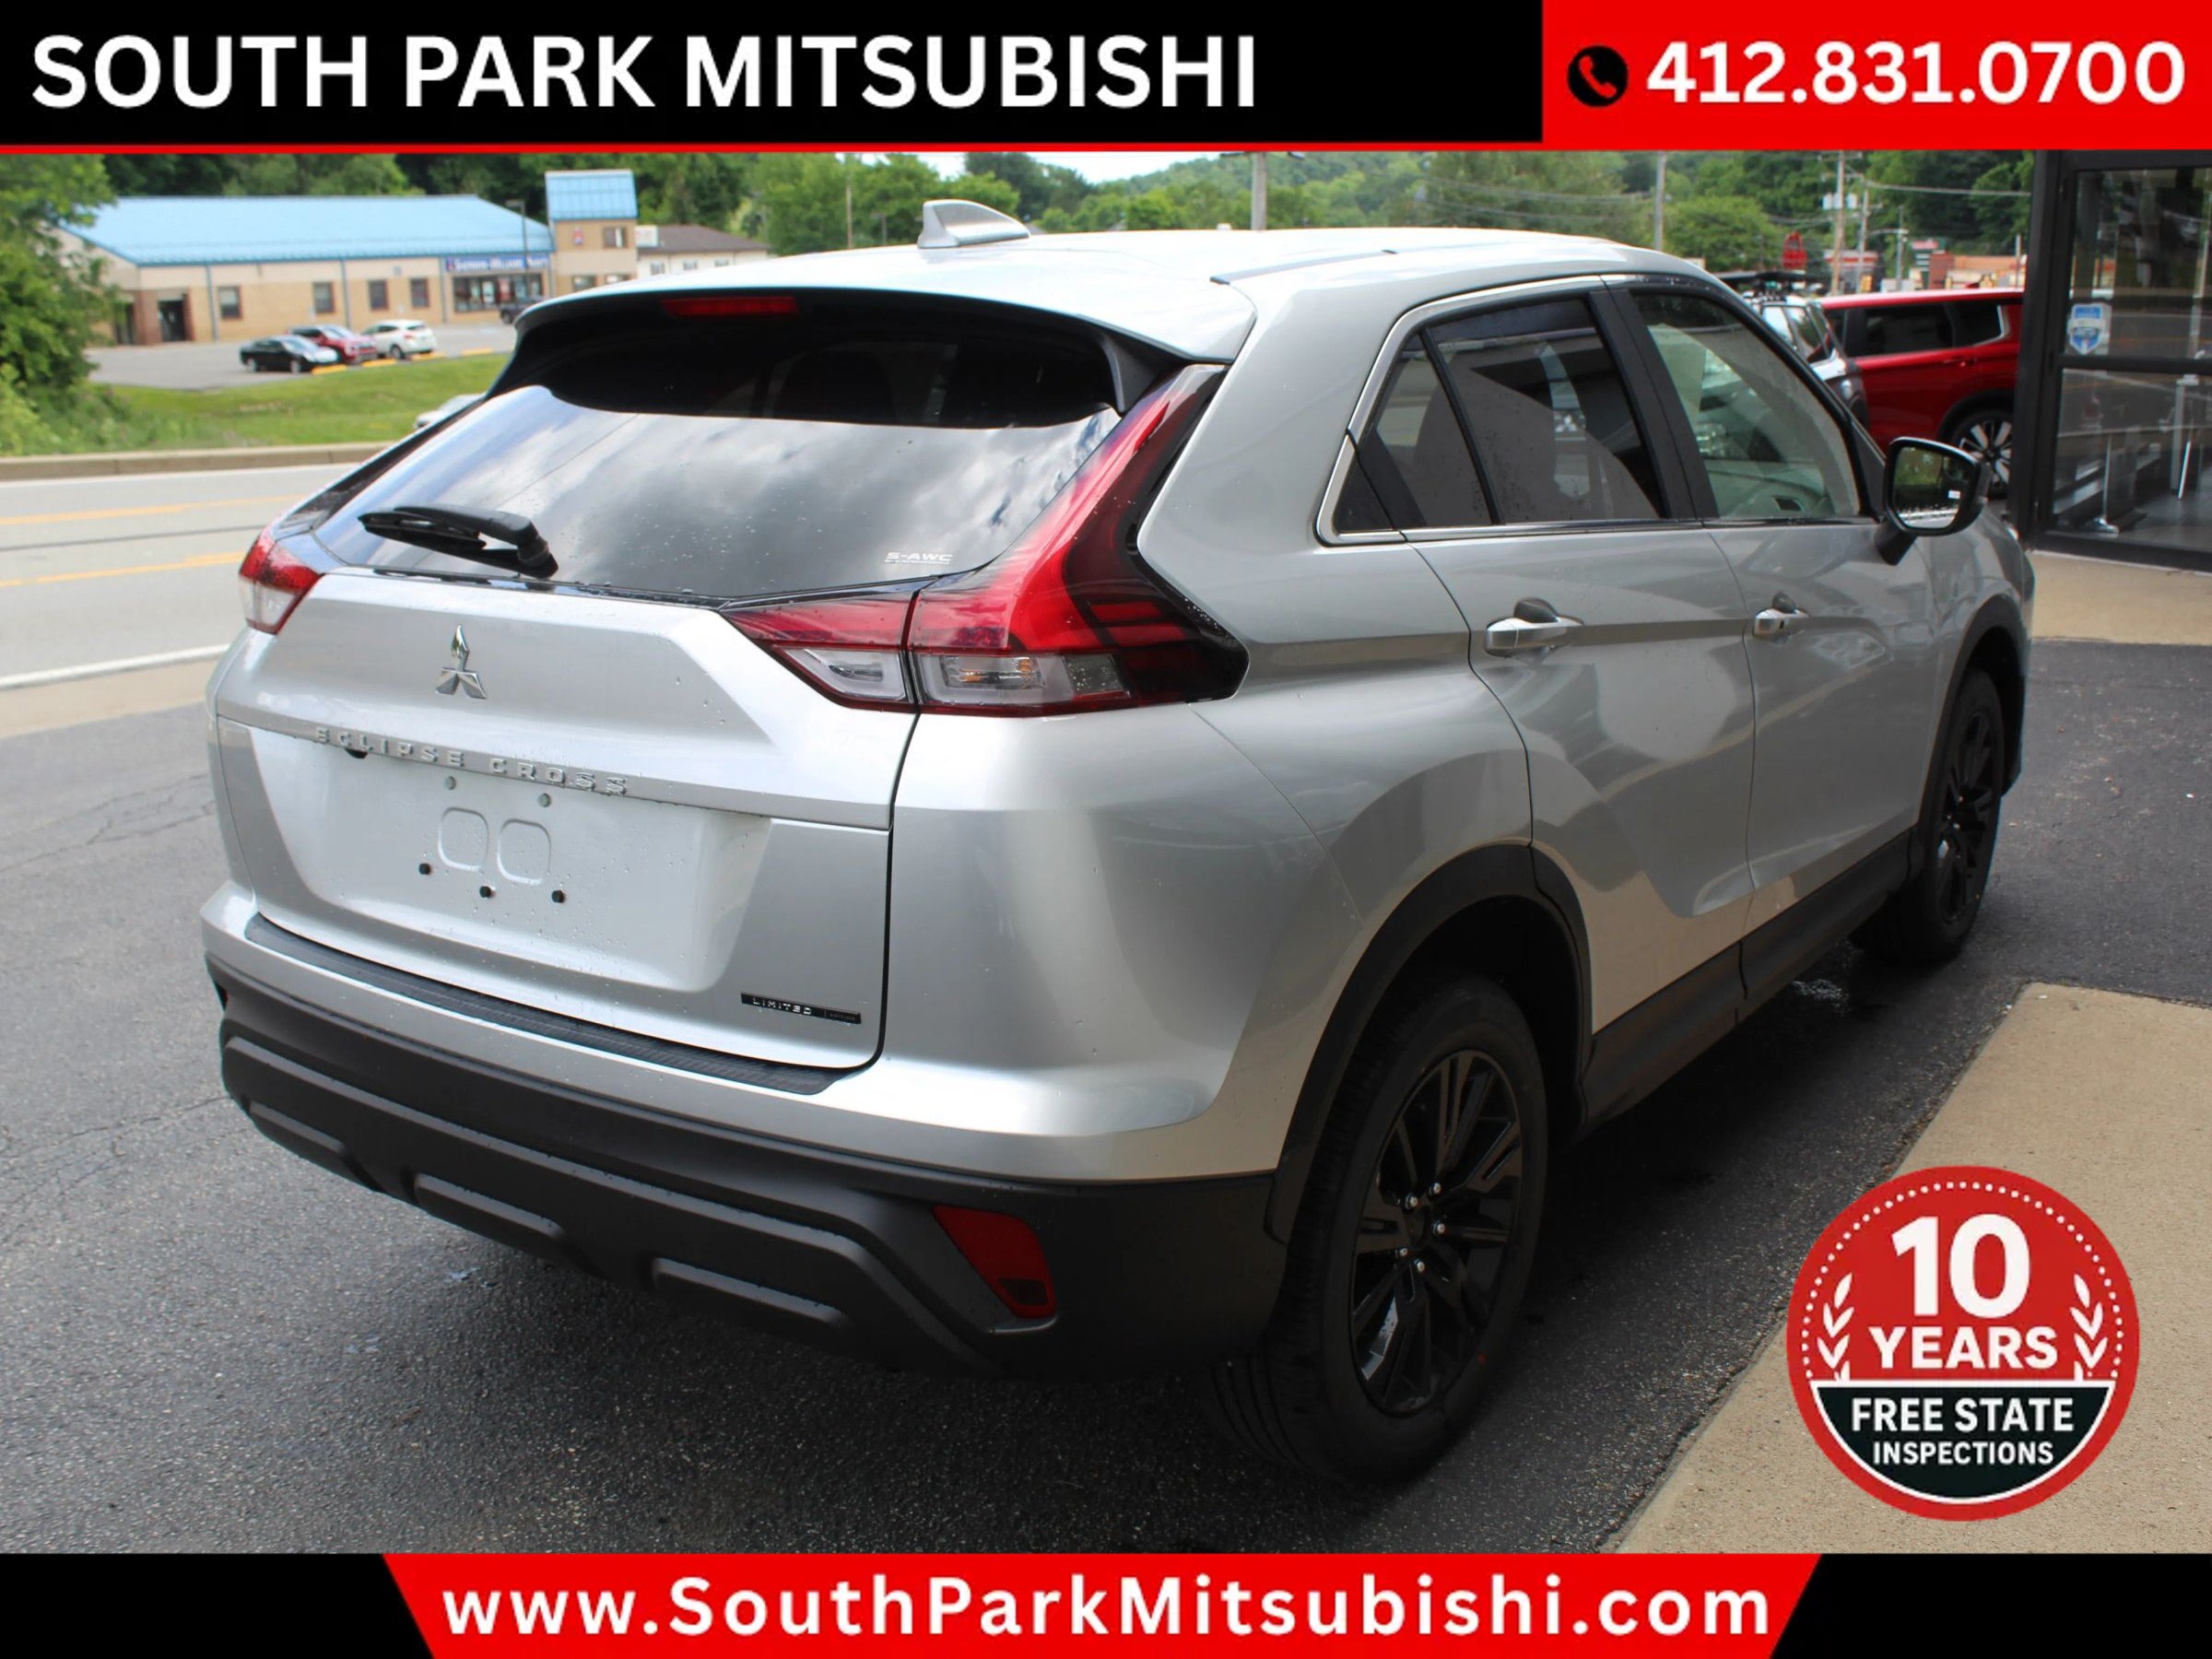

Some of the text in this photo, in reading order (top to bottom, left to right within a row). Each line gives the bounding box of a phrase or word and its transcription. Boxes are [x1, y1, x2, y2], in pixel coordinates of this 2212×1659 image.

[886, 551, 953, 561] S-AWC
[315, 726, 629, 796] ECLIPSE CROSS
[752, 996, 813, 1016] LIMITED
